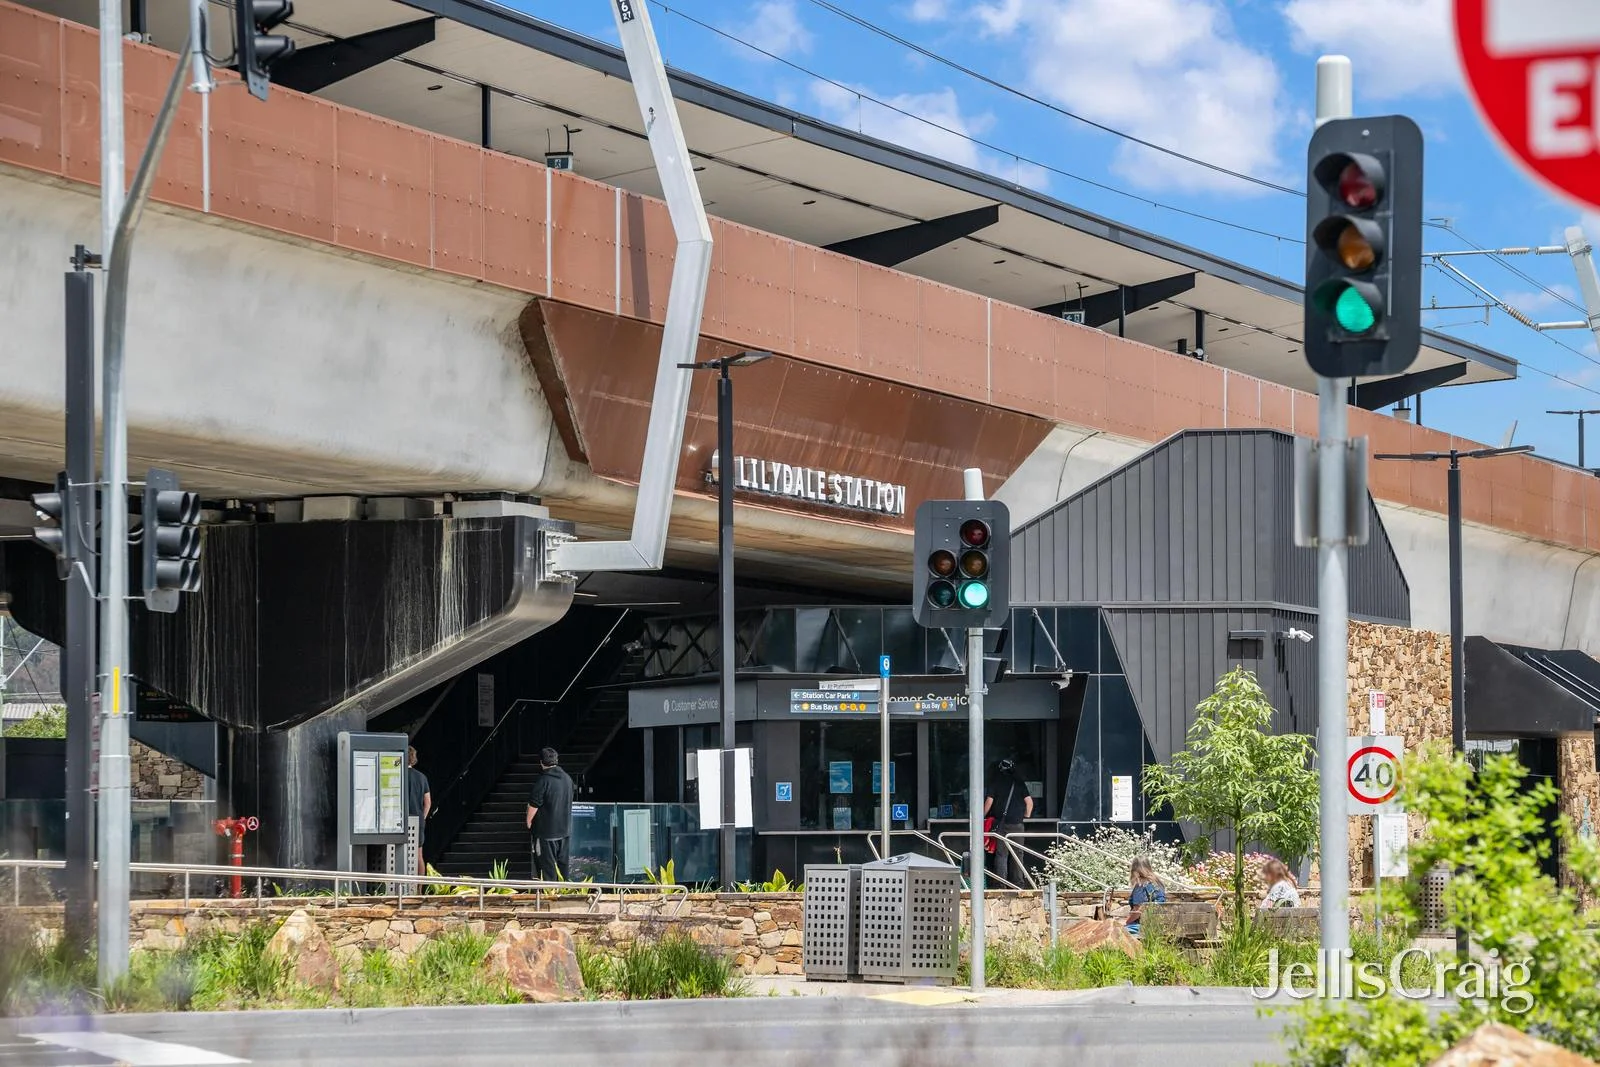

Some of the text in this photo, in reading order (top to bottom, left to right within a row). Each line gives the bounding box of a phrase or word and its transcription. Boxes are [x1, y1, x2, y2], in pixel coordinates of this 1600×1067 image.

[622, 11, 631, 21] 27
[1526, 56, 1600, 159] E
[735, 456, 906, 514] LILYDALE STATION
[671, 698, 719, 712] Customer Service
[823, 703, 838, 712] Bays
[931, 702, 940, 710] Bay
[1354, 762, 1394, 788] 40
